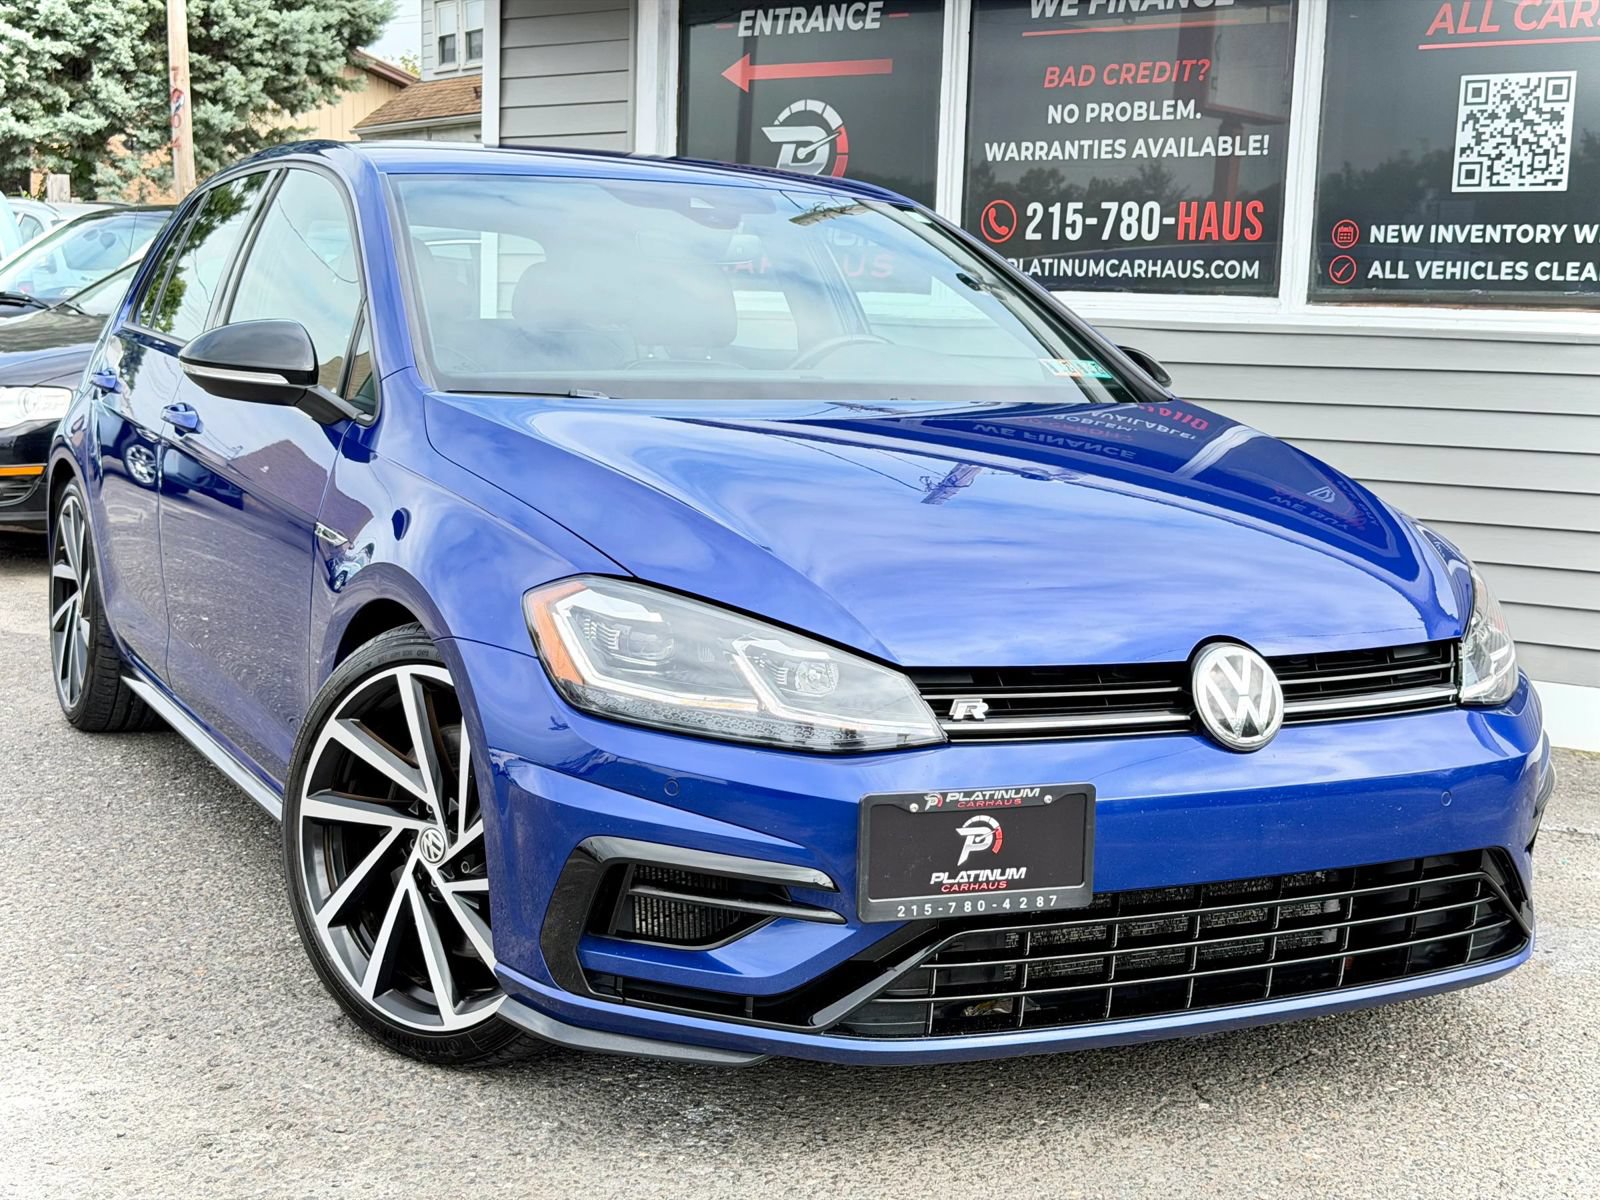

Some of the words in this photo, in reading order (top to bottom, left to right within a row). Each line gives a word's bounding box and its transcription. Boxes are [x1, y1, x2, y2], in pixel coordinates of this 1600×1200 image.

[738, 1, 884, 37] ENTRANCE
[1425, 0, 1501, 36] ALL
[1514, 0, 1600, 31] CAR
[1043, 65, 1096, 88] BAD
[1103, 58, 1212, 85] CREDIT?
[1047, 103, 1080, 124] NO
[1085, 99, 1202, 123] PROBLEM.
[984, 138, 1127, 162] WARRANTIES
[1131, 134, 1270, 159] AVAILABLE!
[1025, 200, 1264, 241] 215-780-HAUS
[1369, 224, 1424, 244] NEW
[1429, 223, 1568, 244] INVENTORY
[1573, 224, 1600, 244] W
[1367, 260, 1409, 280] ALL
[1415, 260, 1529, 281] VEHICLES
[1534, 261, 1600, 281] CLEA
[949, 698, 989, 721] R
[946, 787, 1041, 803] PLATINUM
[957, 798, 1022, 809] CARHAUS
[930, 866, 1027, 885] PLATINUM
[941, 880, 1008, 893] CARHAUS
[897, 895, 1057, 917] 215-780-4287
